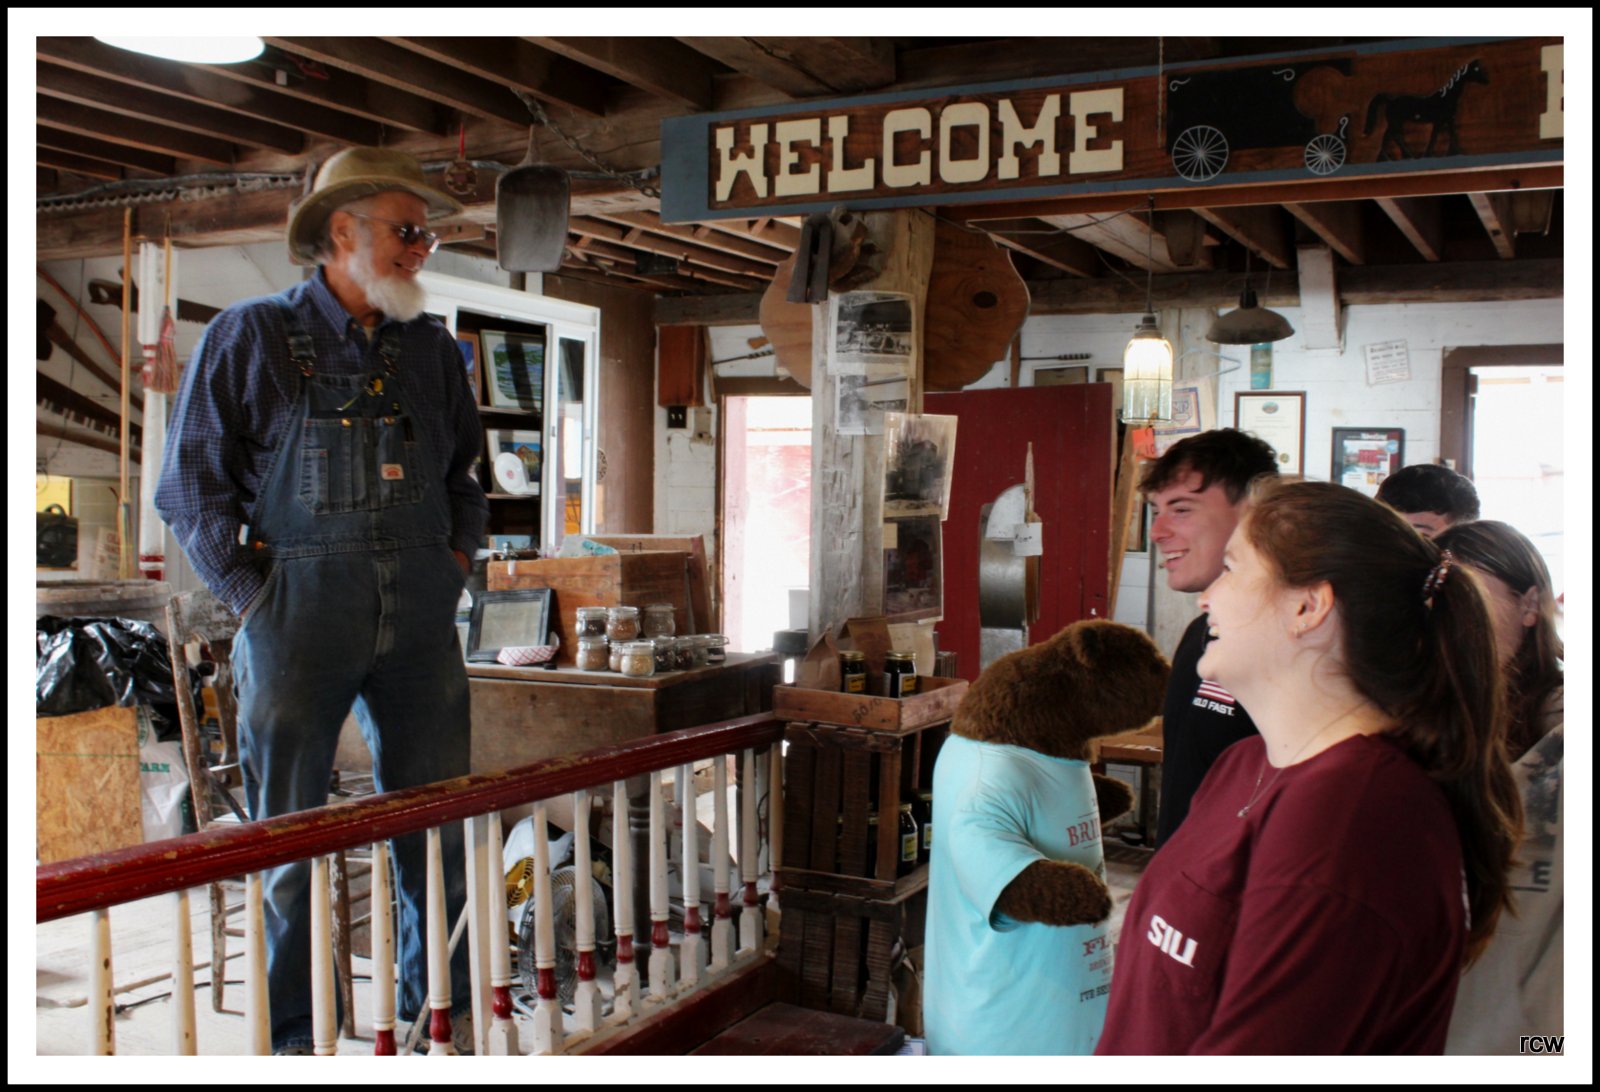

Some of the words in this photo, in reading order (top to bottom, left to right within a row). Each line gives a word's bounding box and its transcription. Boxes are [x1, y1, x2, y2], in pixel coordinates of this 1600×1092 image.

[715, 87, 1124, 201] WELCOME
[1082, 935, 1109, 957] FL
[1147, 914, 1198, 968] SIU
